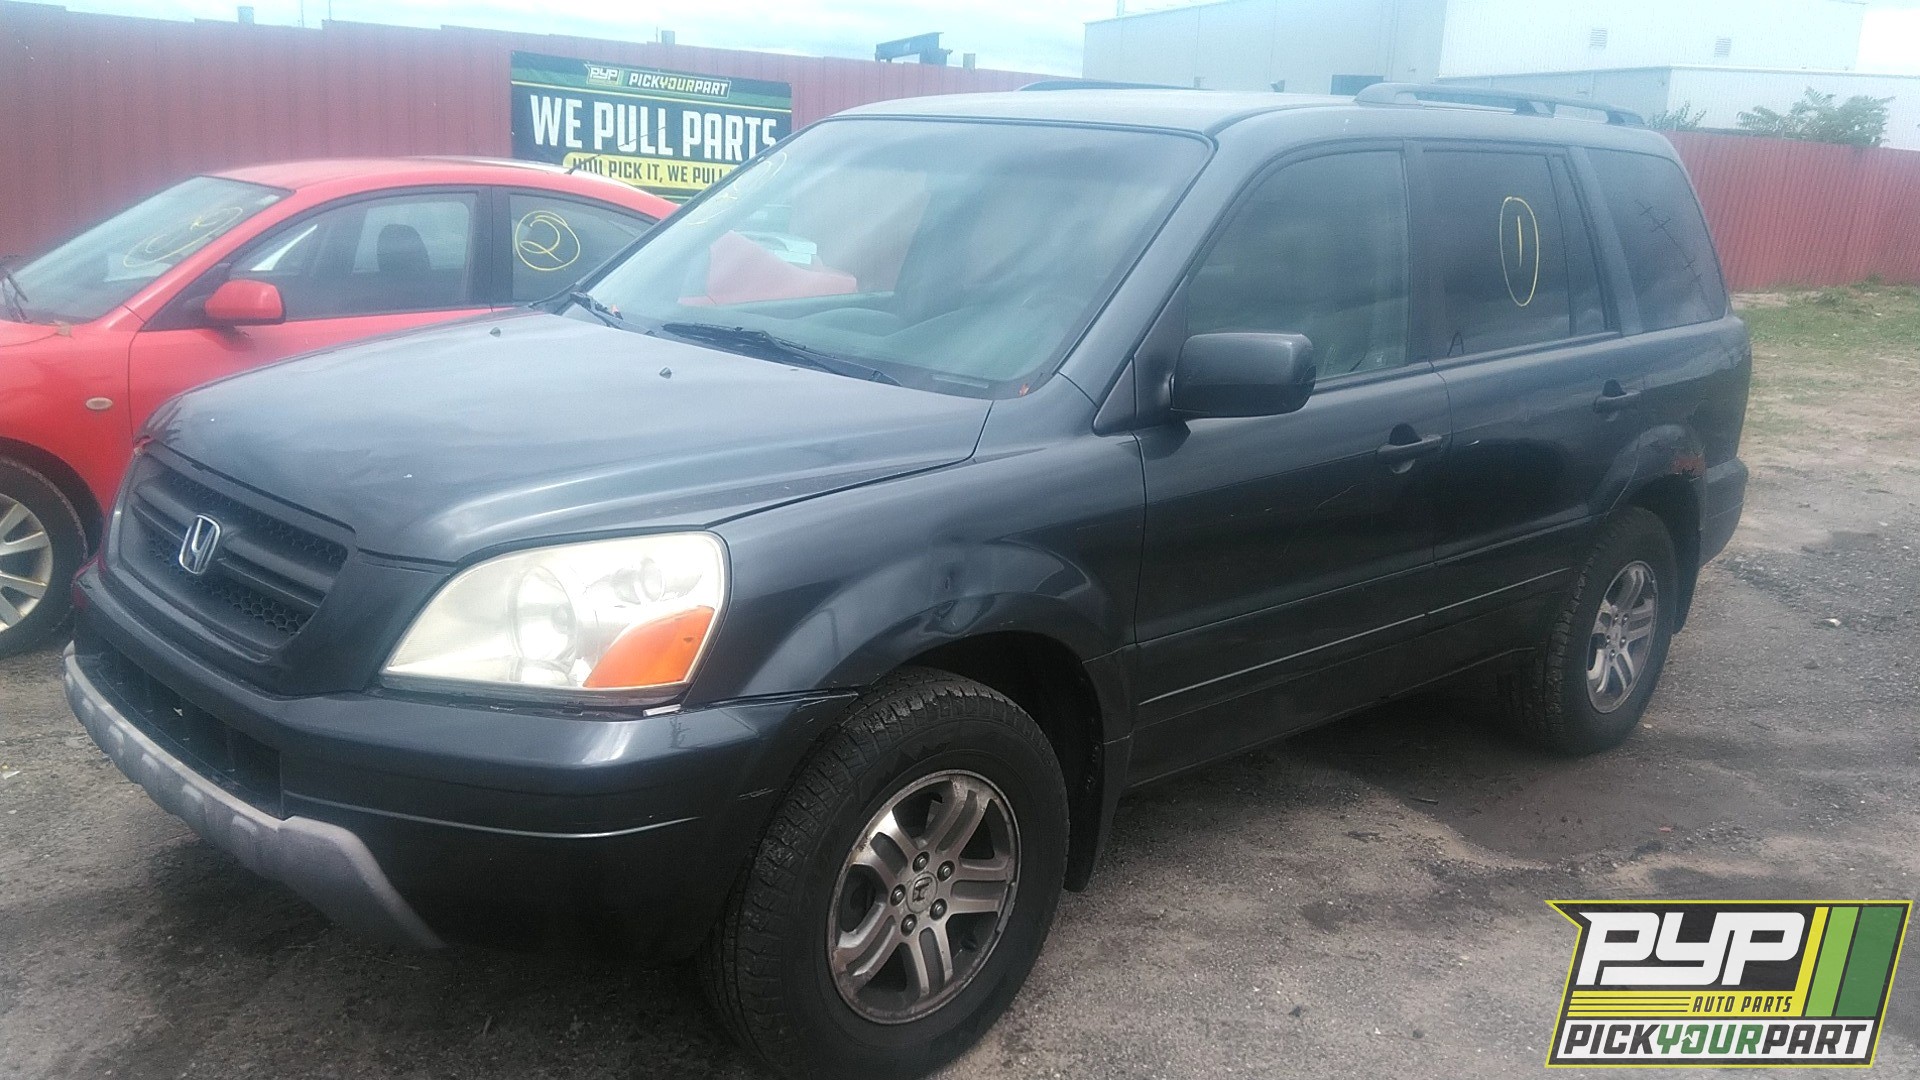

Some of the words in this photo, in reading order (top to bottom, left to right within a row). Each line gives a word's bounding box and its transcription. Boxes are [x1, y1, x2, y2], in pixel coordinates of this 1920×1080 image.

[589, 67, 618, 80] PYP
[629, 72, 728, 95] PICKYOURPART
[530, 94, 582, 149] WE
[594, 101, 673, 155] PULL
[682, 110, 777, 161] PARTS
[608, 160, 642, 179] PICK
[647, 164, 663, 183] IT,
[667, 165, 687, 182] WE
